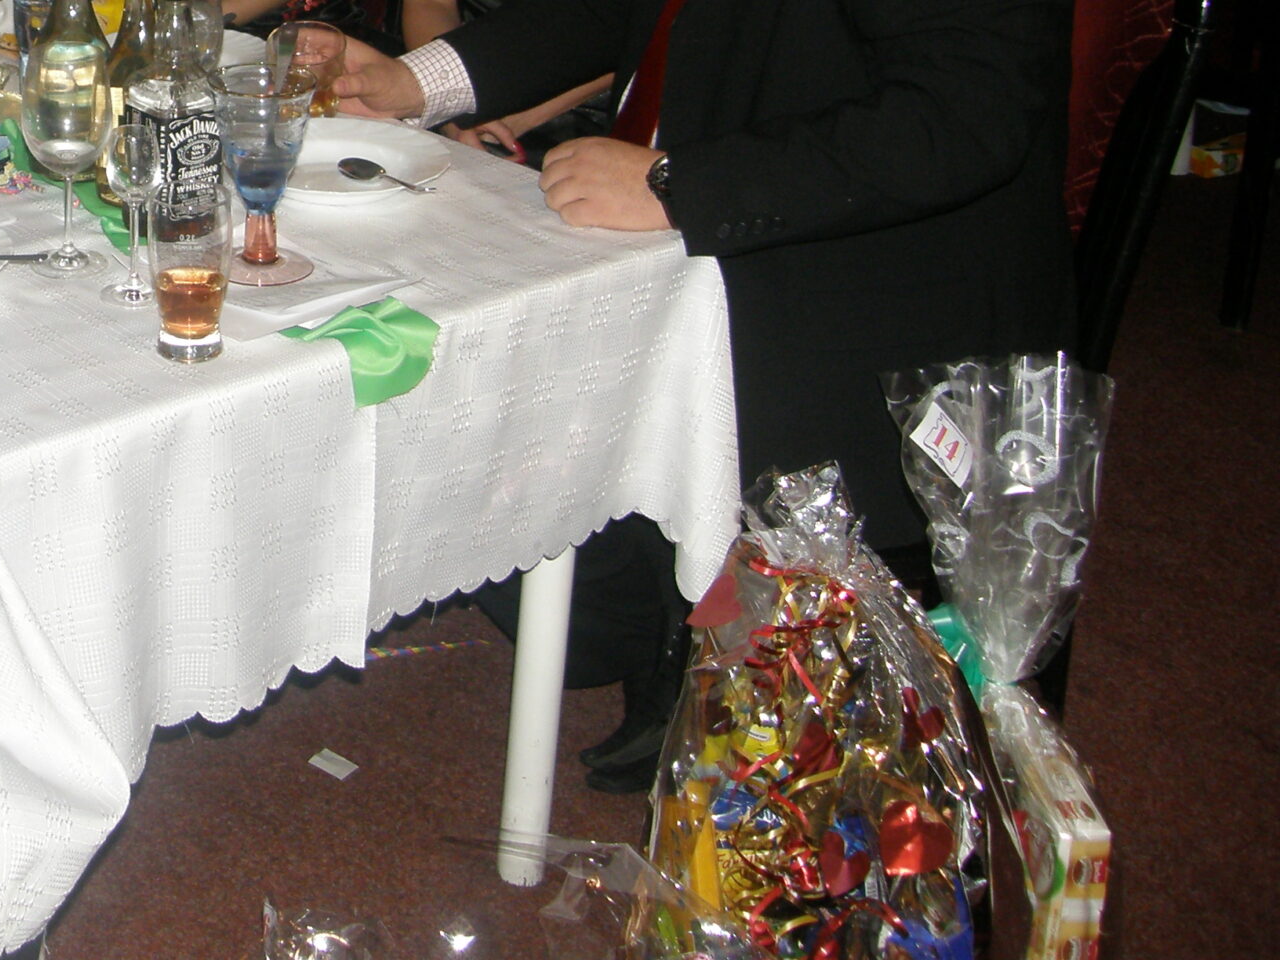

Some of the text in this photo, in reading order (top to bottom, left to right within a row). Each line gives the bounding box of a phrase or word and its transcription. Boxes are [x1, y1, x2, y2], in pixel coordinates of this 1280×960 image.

[168, 124, 193, 149] JACK
[177, 164, 218, 180] Tennessee
[932, 424, 960, 461] 14
